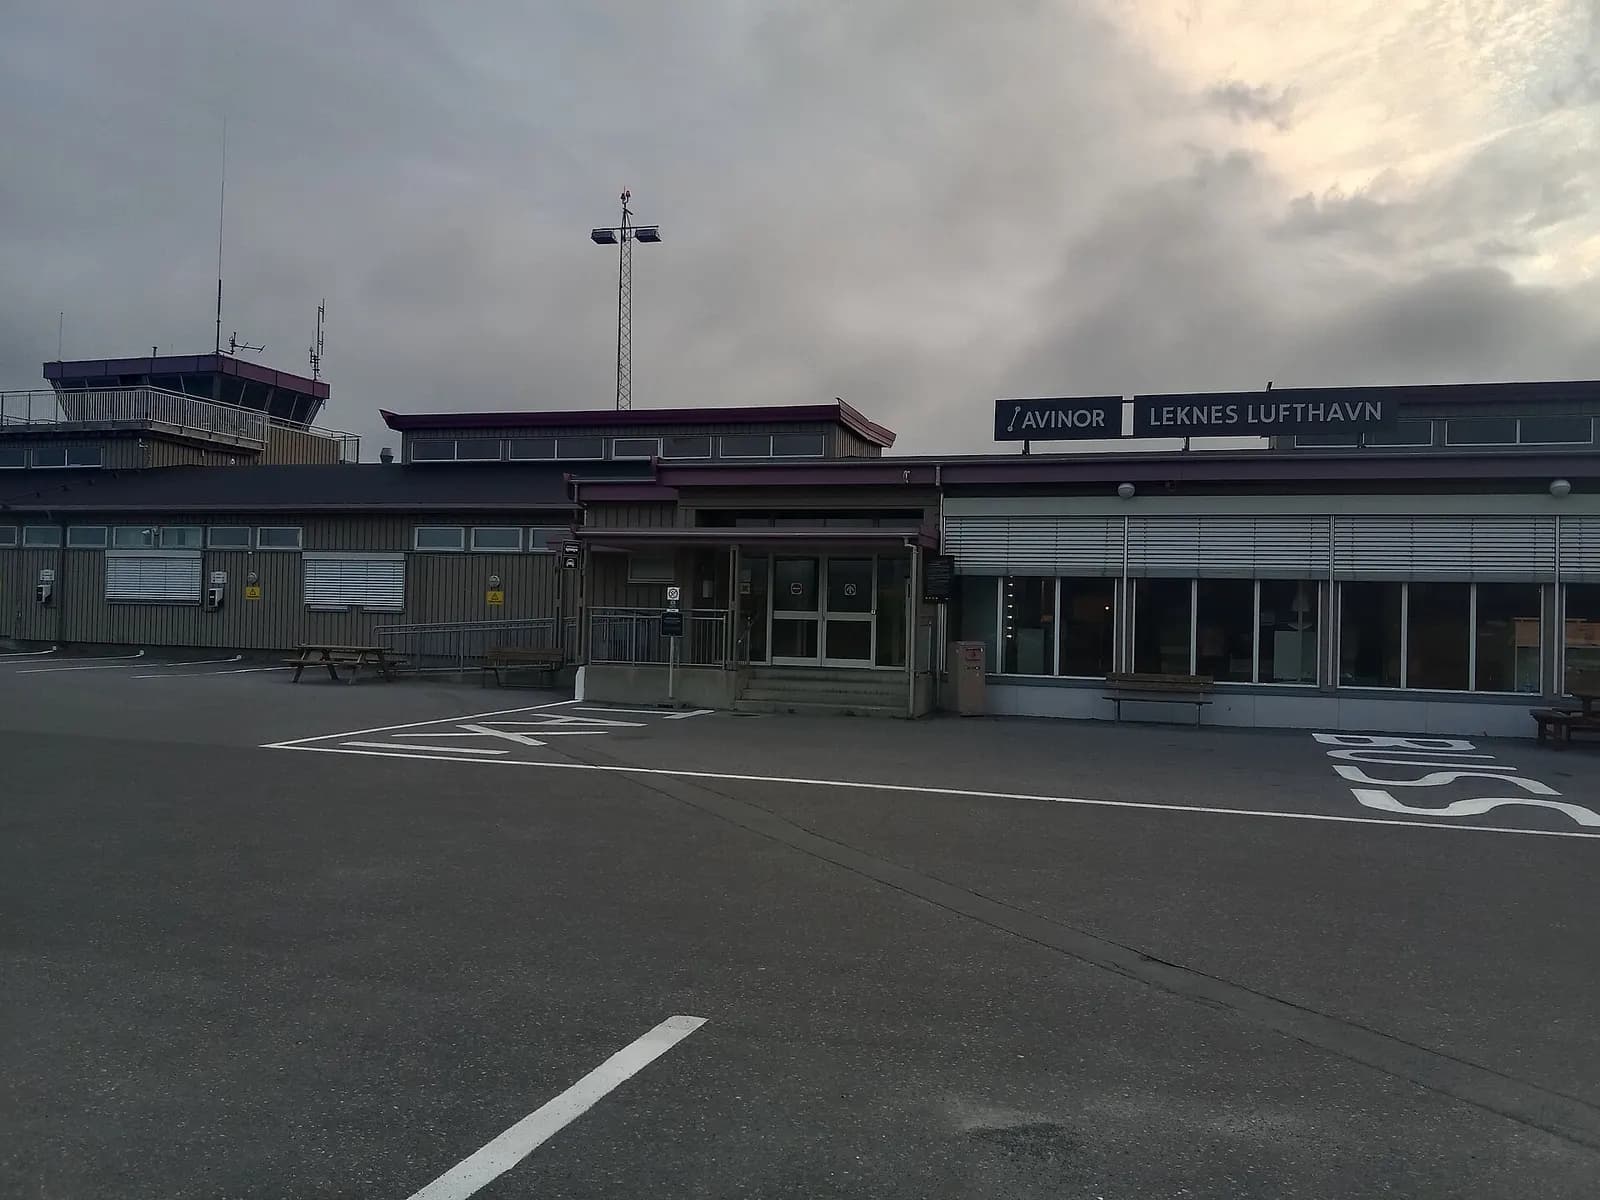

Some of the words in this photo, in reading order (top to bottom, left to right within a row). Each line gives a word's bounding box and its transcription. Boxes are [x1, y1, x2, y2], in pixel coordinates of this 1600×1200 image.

[1021, 409, 1105, 429] AVINOR
[1150, 405, 1239, 426] LEKNES
[1248, 401, 1382, 424] LUFTHAVN
[339, 706, 715, 754] TAXI
[1312, 733, 1600, 827] BUSS
